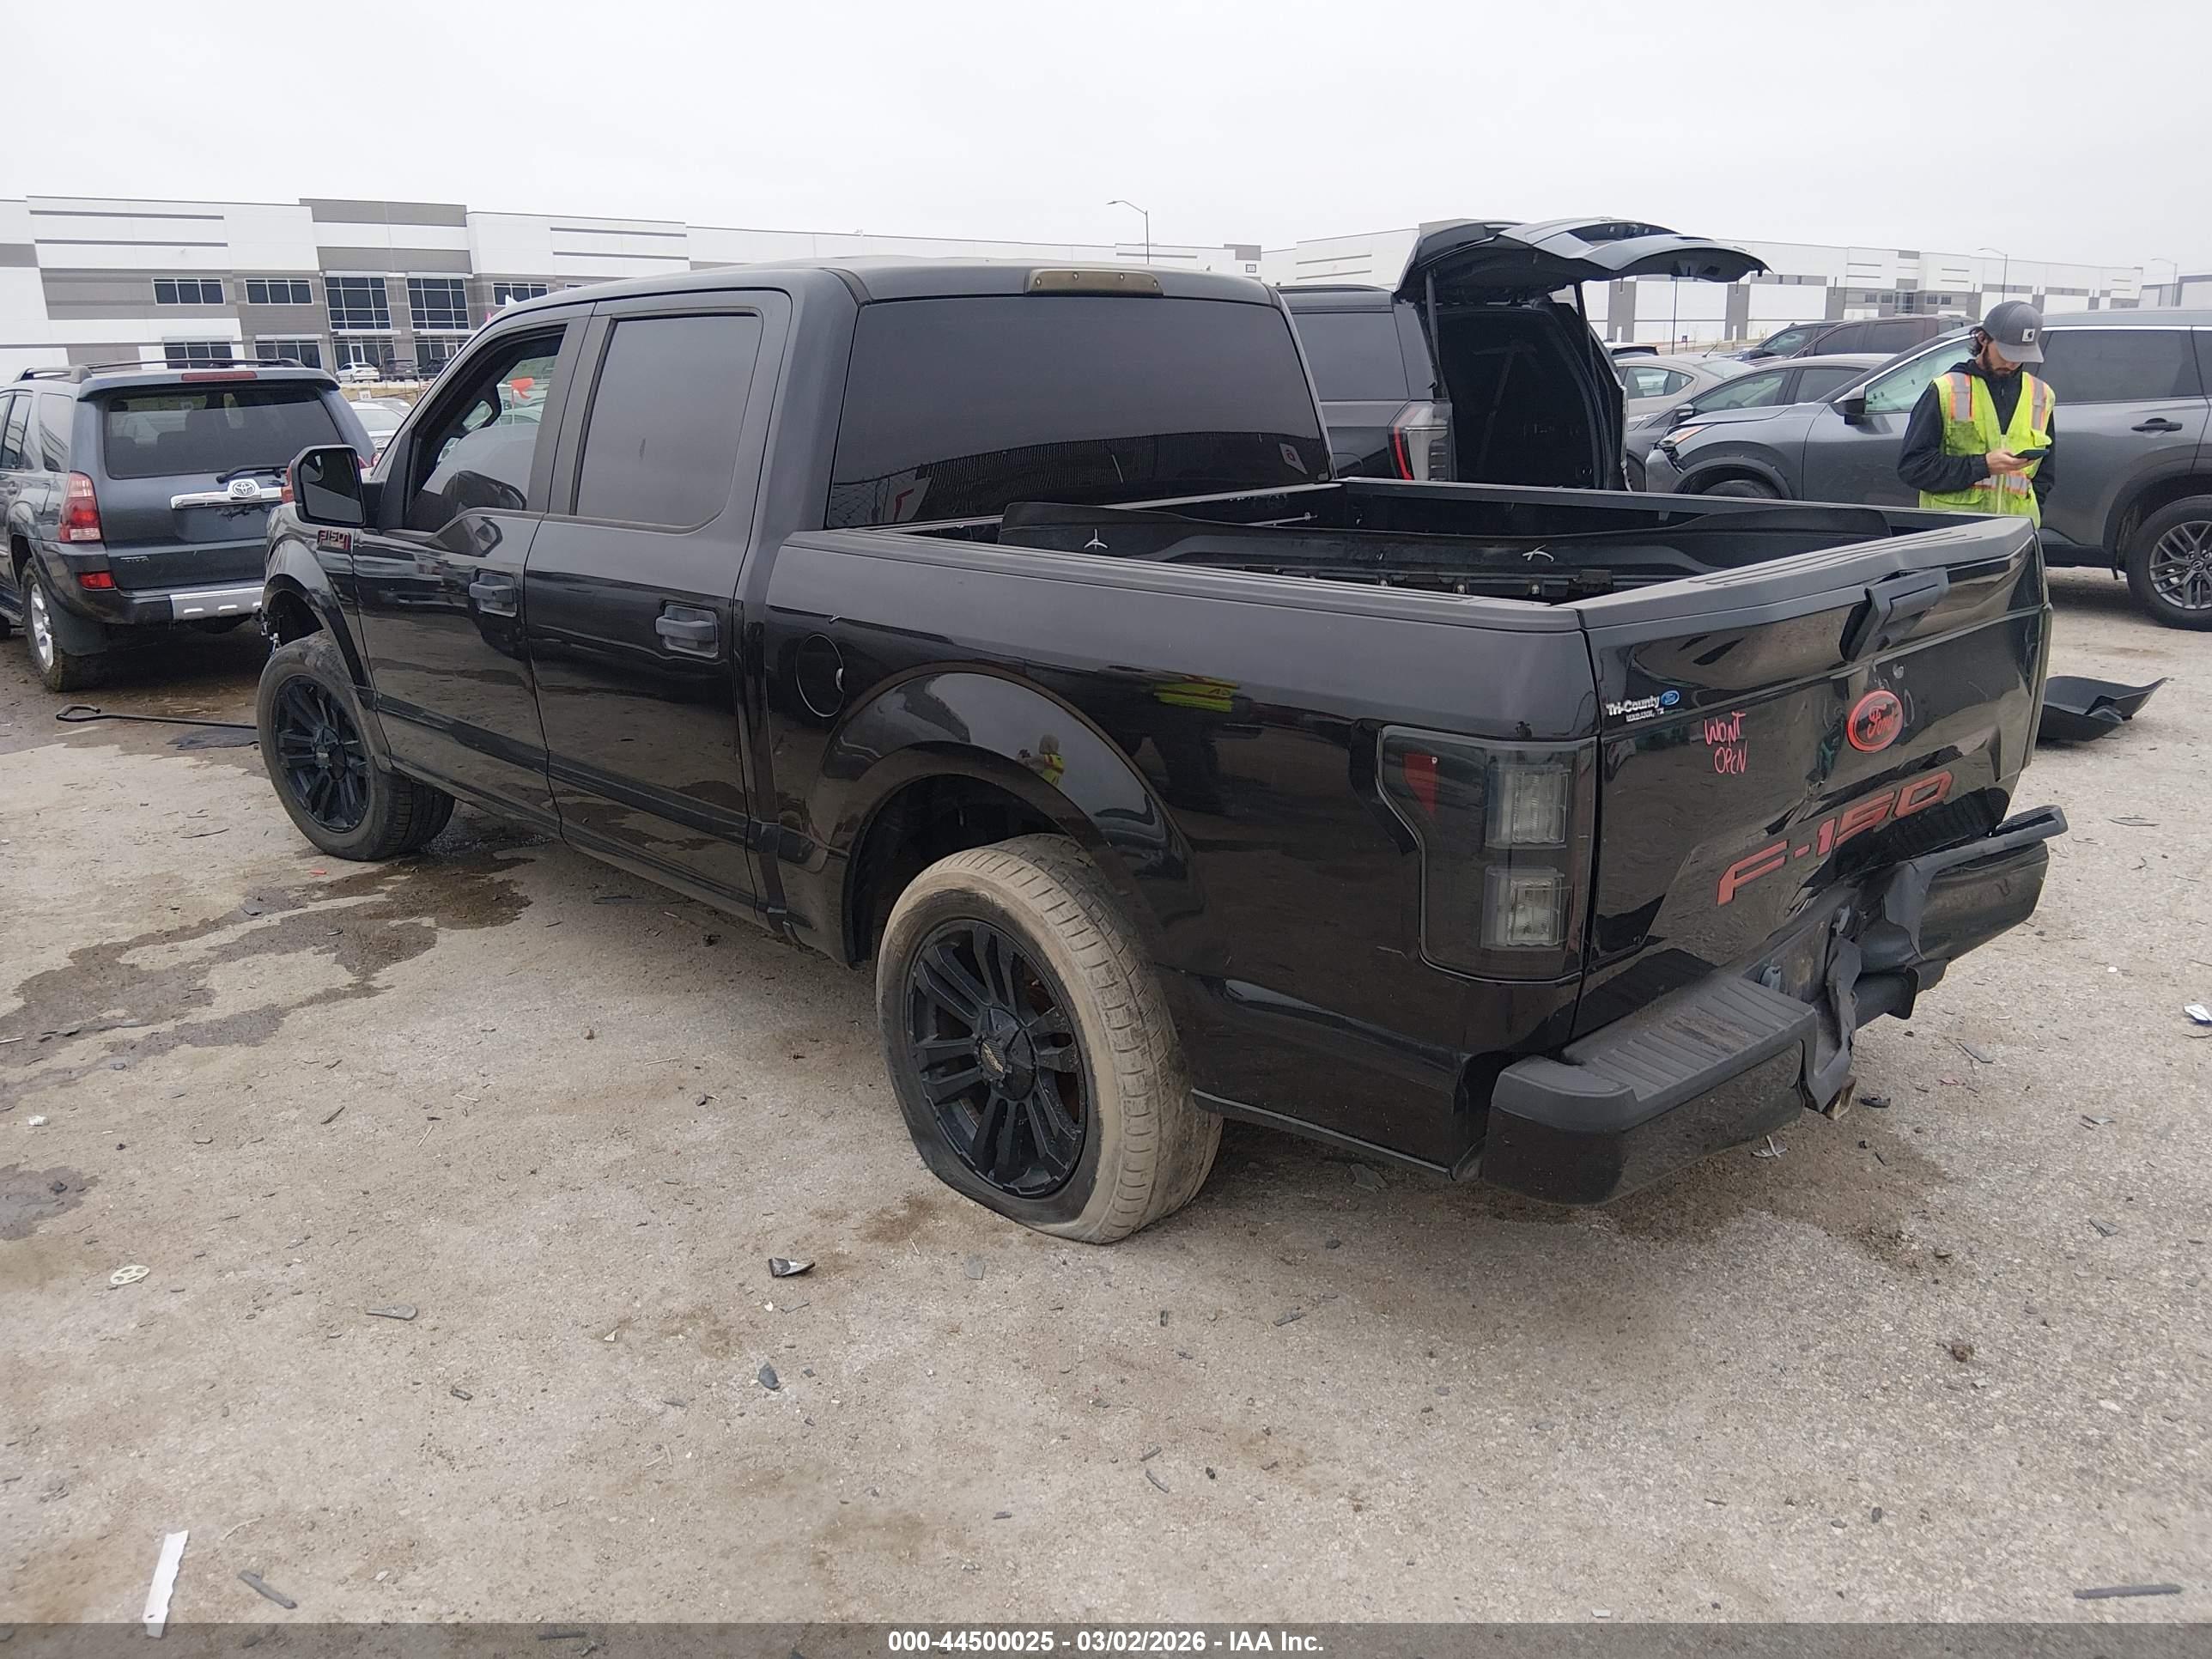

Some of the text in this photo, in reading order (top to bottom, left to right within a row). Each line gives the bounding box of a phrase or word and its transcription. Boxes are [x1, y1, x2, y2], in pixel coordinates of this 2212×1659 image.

[1605, 695, 1660, 716] Tri-County
[1867, 703, 1895, 739] Ford
[1717, 769, 1954, 906] F-150
